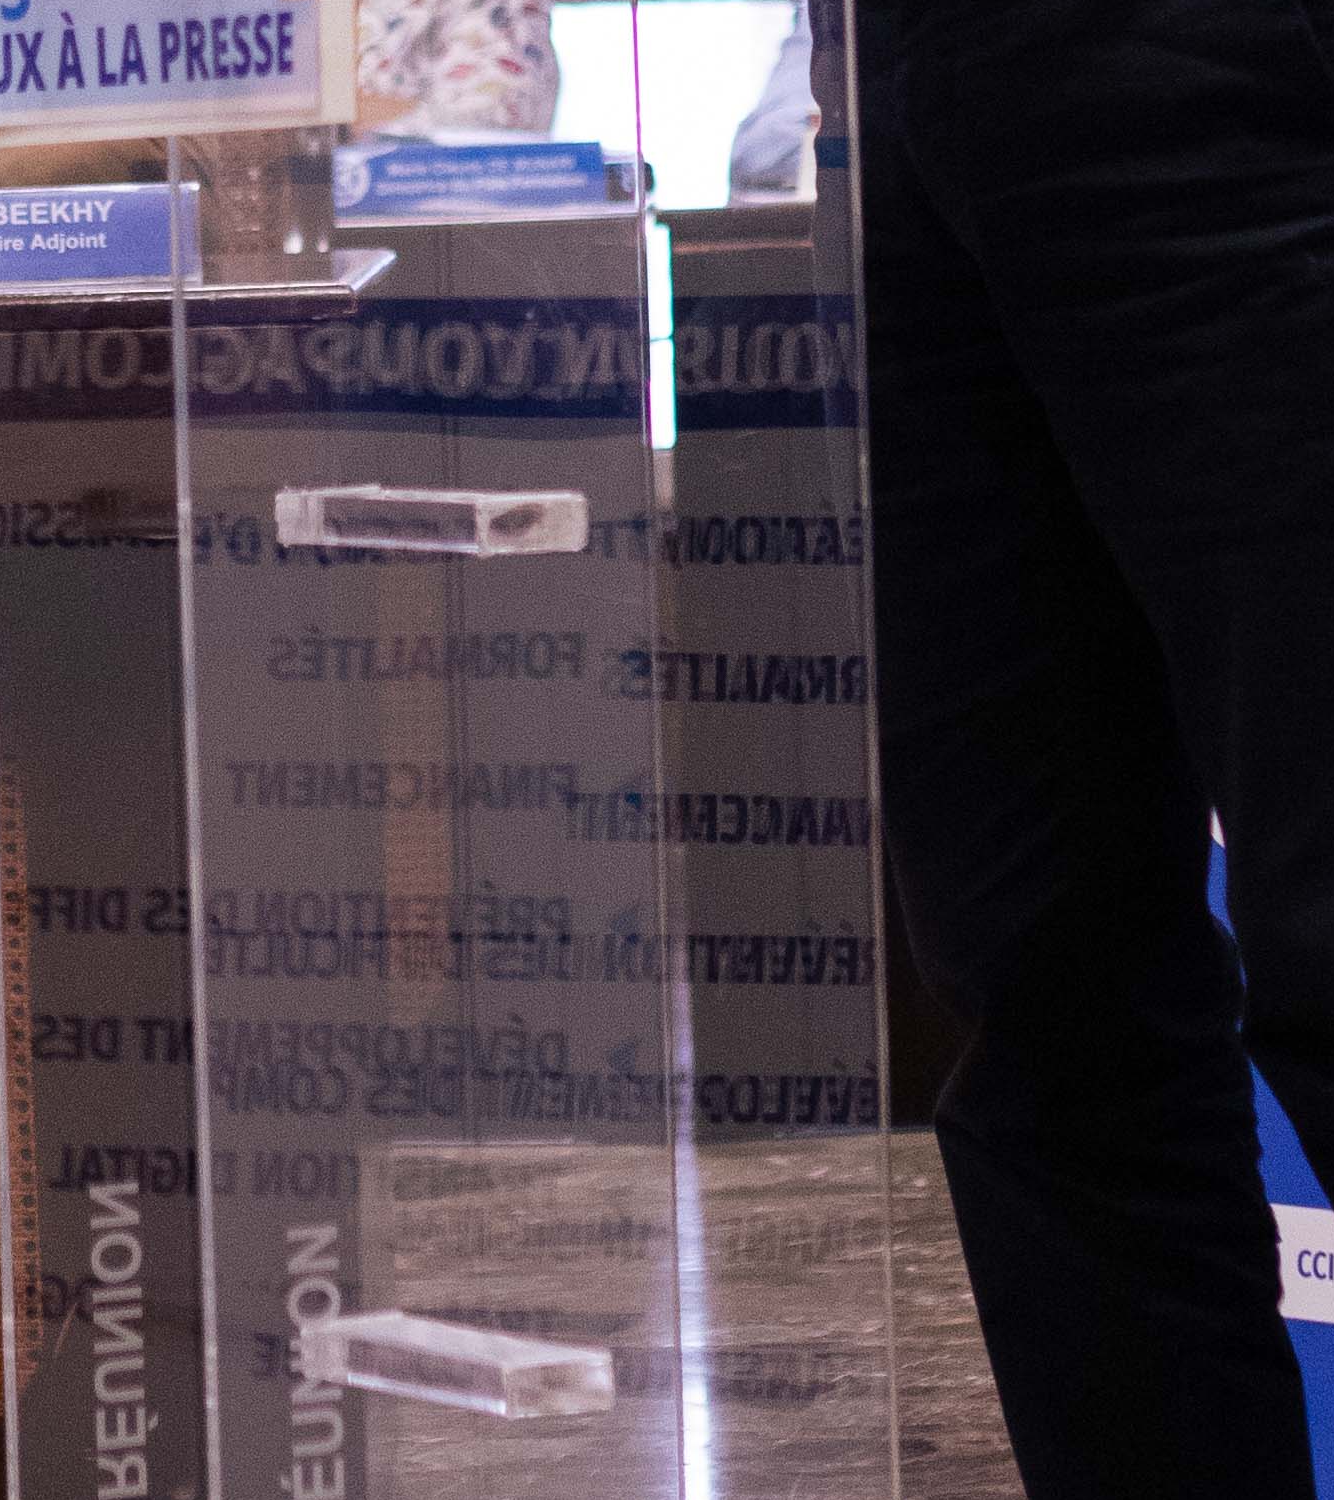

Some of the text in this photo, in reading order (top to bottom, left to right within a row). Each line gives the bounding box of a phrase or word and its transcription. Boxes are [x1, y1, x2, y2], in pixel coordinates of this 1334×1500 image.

[57, 10, 85, 89] À
[96, 23, 147, 88] LA
[158, 11, 294, 84] PRESSE
[30, 231, 107, 254] Adjoint
[1297, 1250, 1334, 1280] CCI
